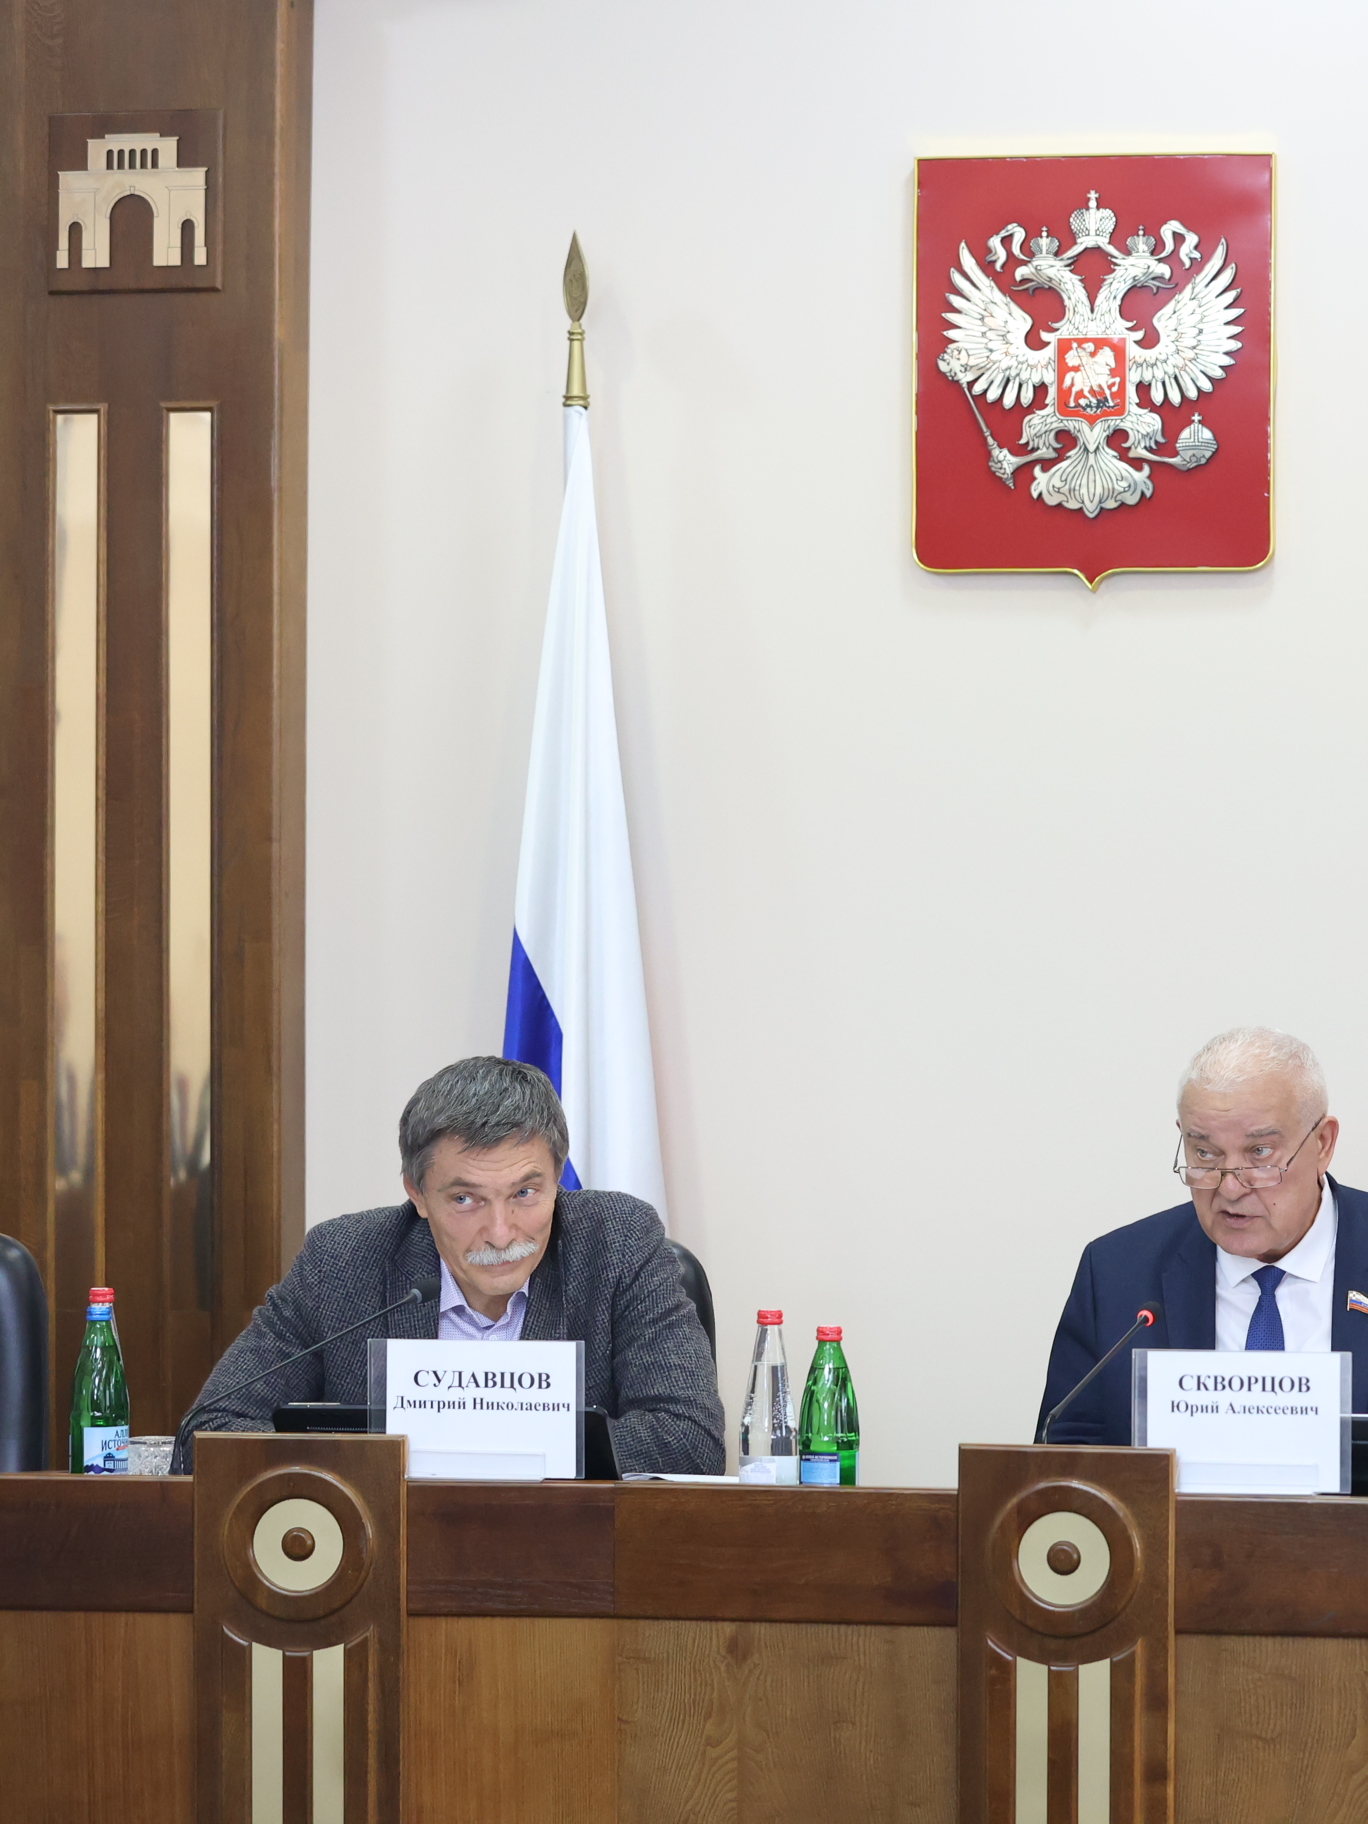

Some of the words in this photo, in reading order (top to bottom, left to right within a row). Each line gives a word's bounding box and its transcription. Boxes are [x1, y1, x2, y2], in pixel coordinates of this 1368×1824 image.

[413, 1369, 552, 1393] СУДАВЦОВ
[1178, 1374, 1312, 1396] СКВОРЦОВ
[393, 1395, 467, 1413] Дмитрий
[472, 1397, 571, 1412] Николаевич
[1170, 1399, 1220, 1417] Юрий
[1225, 1401, 1319, 1416] Алексеевич
